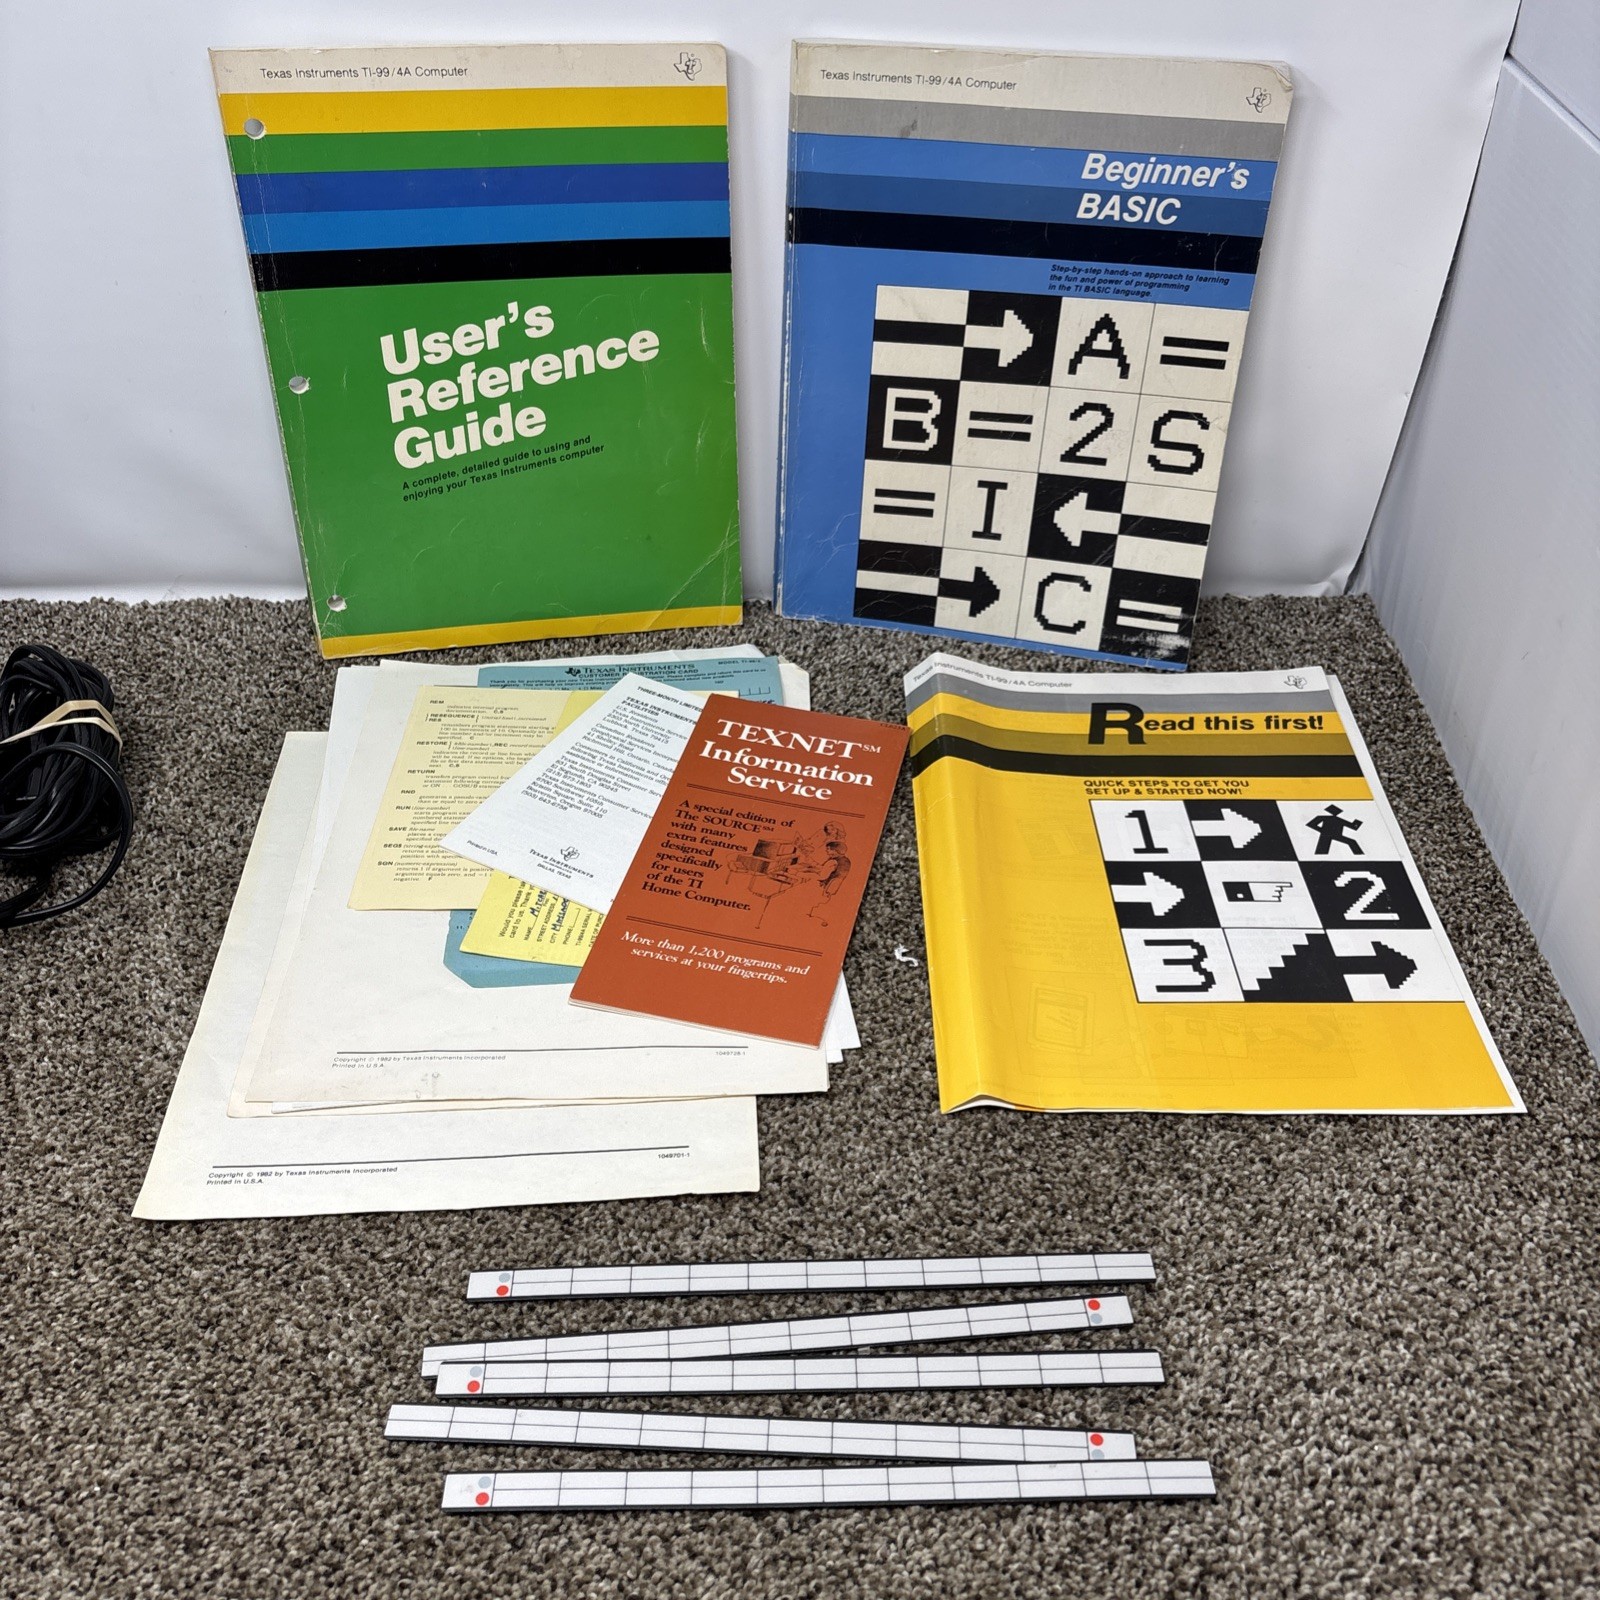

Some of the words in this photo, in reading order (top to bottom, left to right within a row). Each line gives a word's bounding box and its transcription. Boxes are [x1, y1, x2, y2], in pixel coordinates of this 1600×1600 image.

[259, 68, 292, 78] Texas
[295, 68, 359, 78] Instruments
[361, 66, 411, 77] TI-99/4A
[415, 66, 468, 78] Computer
[820, 69, 849, 80] Texas
[852, 71, 912, 84] Instruments
[915, 74, 962, 86] TI-99/4A
[965, 77, 1016, 90] Computer
[1081, 152, 1250, 190] Beginner's
[1076, 192, 1182, 226] BASIC
[1051, 264, 1102, 275] Step-by-step
[1103, 268, 1142, 276] hands-on
[1195, 274, 1230, 285] learning
[1134, 280, 1190, 292] programming
[1083, 285, 1110, 293] BASIC
[1112, 287, 1152, 298] language.
[380, 301, 555, 376] User's
[1067, 313, 1131, 380] A
[387, 330, 660, 424] Reference
[394, 402, 547, 469] Guide
[882, 386, 941, 452] B
[1060, 401, 1115, 467] 2
[1147, 409, 1211, 476] S
[402, 481, 409, 490] A
[412, 470, 459, 487] complete,
[461, 457, 500, 474] detailed
[502, 451, 529, 466] guide
[544, 441, 570, 453] using
[573, 435, 590, 446] and
[403, 486, 443, 502] enjoying
[446, 479, 466, 492] your
[469, 472, 497, 483] Texas
[500, 456, 557, 476] Instruments
[559, 445, 604, 461] computer
[1034, 572, 1092, 635] C
[934, 662, 984, 679] Instruments
[985, 675, 1026, 687] TI-99/4A
[1028, 680, 1073, 689] Computer
[621, 700, 659, 716] FACILITIES
[626, 696, 648, 706] TEXAS
[1087, 702, 1195, 745] Read
[1204, 715, 1253, 731] this
[1264, 714, 1324, 731] first!
[698, 740, 875, 787] Information
[726, 767, 832, 800] Service
[676, 809, 699, 821] The
[702, 815, 760, 833] SOURCE
[679, 799, 689, 808] A
[693, 804, 734, 816] special
[735, 811, 776, 824] edition
[666, 832, 696, 842] extra
[699, 835, 747, 851] features
[671, 821, 696, 831] with
[700, 827, 735, 839] many
[1124, 809, 1169, 854] 1
[529, 848, 548, 859] TEXAS
[548, 855, 594, 878] INSTRUMENTS
[655, 851, 723, 871] specifically
[660, 840, 714, 857] designed
[646, 872, 663, 880] of
[663, 874, 683, 885] the
[688, 877, 703, 888] TI
[651, 860, 670, 871] for
[672, 866, 704, 877] users
[641, 881, 681, 896] Home
[684, 890, 750, 910] Computer.
[1334, 871, 1400, 921] 2
[621, 931, 654, 945] More
[657, 939, 684, 951] than
[688, 945, 724, 959] 1,200
[724, 954, 781, 969] programs
[784, 965, 810, 974] and
[630, 948, 678, 962] services
[697, 961, 725, 971] your
[727, 964, 787, 983] fingertips.
[1143, 938, 1217, 993] 3
